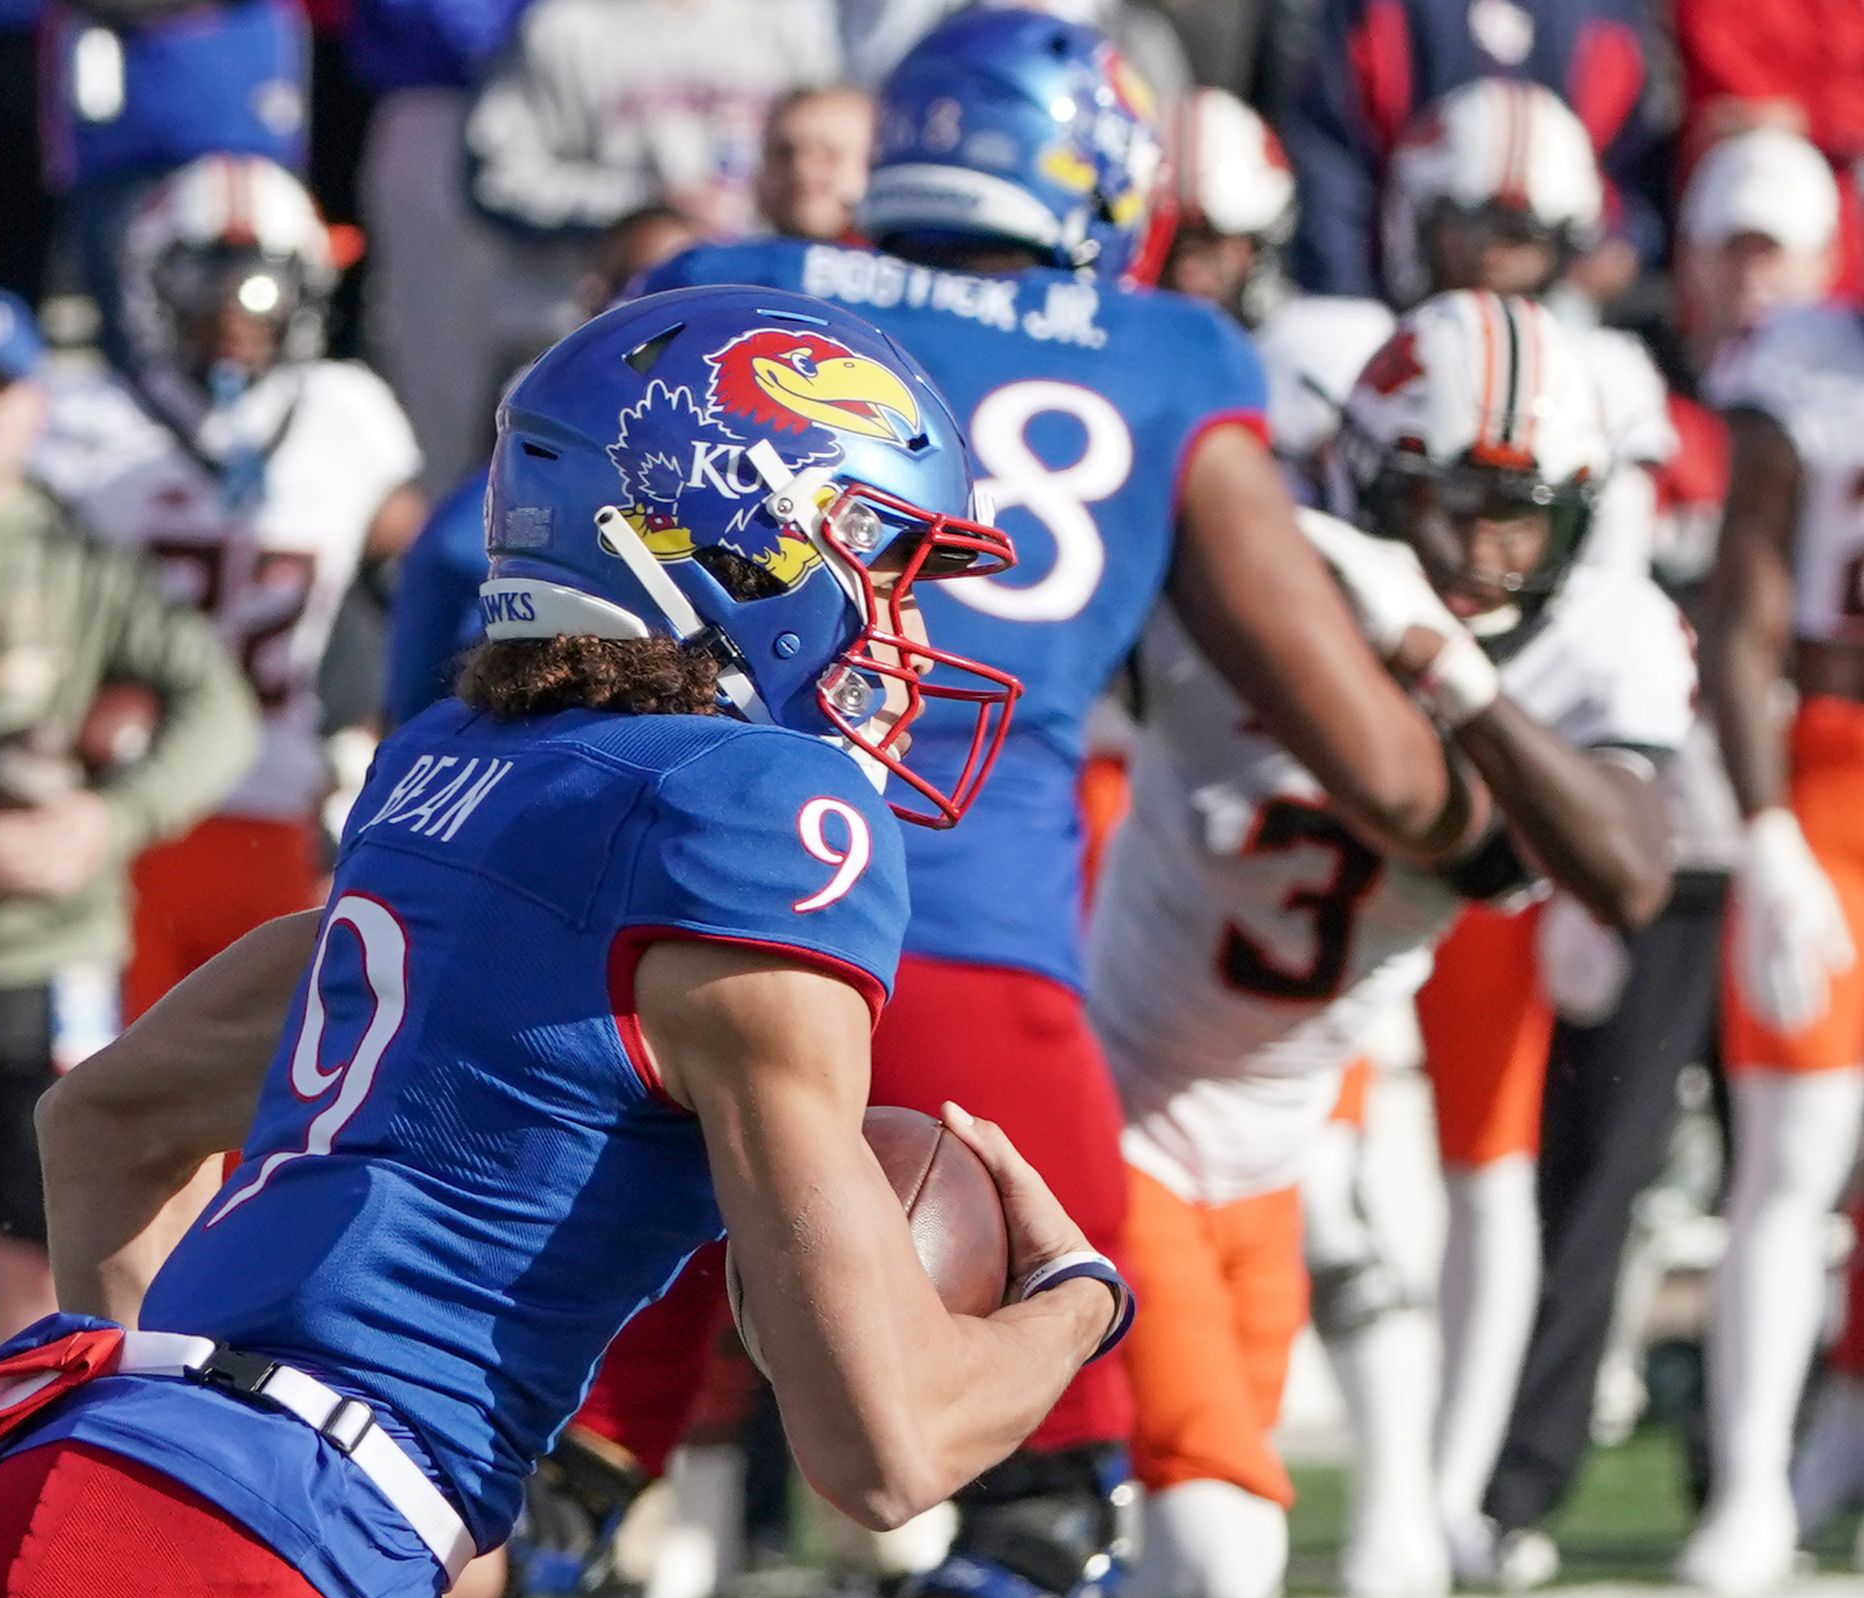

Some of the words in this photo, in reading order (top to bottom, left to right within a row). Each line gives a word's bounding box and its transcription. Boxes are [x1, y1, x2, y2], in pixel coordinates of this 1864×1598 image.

[686, 440, 766, 500] KU
[358, 755, 514, 842] BEAN
[792, 795, 873, 914] 9
[1217, 797, 1386, 1000] 3
[203, 890, 409, 1230] 9
